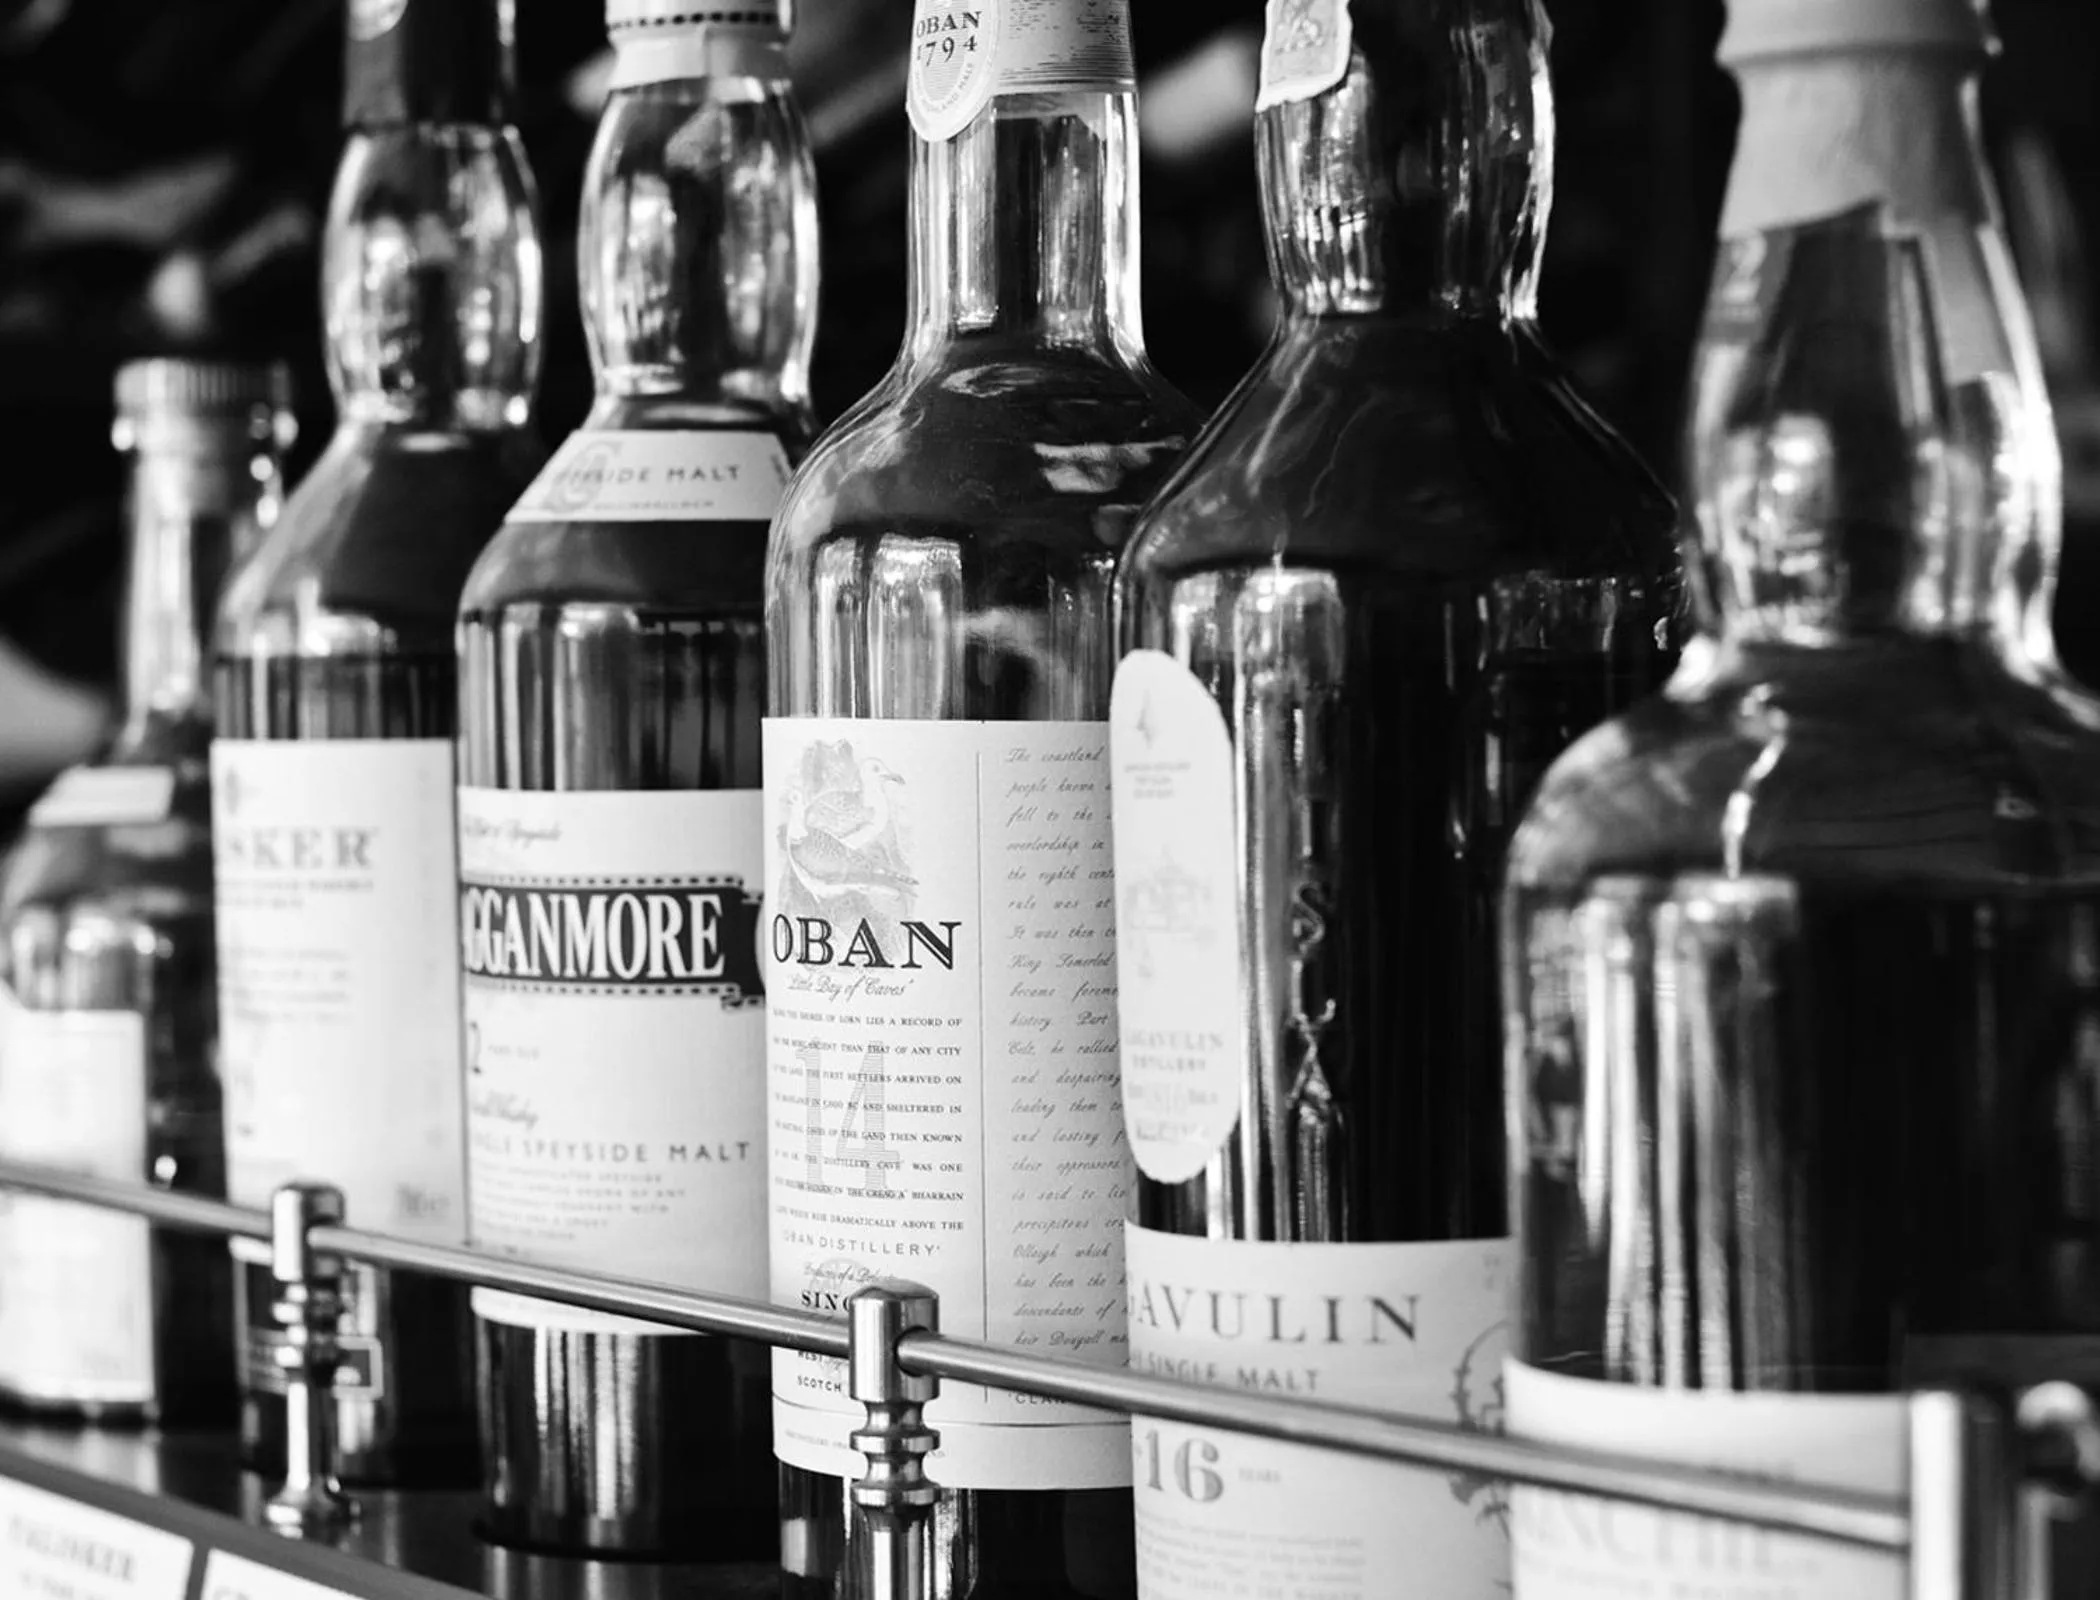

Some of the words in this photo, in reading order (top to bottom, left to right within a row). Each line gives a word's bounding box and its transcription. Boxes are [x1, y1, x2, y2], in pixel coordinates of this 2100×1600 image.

[916, 10, 983, 39] OBAN
[916, 34, 979, 68] 1794
[666, 465, 741, 482] MALT
[1005, 748, 1031, 763] The
[1041, 745, 1106, 762] coastland
[1005, 777, 1048, 799] people
[1057, 777, 1096, 793] known
[1005, 805, 1039, 828] fell
[1046, 809, 1060, 821] to
[1072, 805, 1094, 821] the
[1006, 831, 1080, 856] overlordship
[1091, 839, 1105, 850] in
[1007, 865, 1027, 880] the
[1039, 864, 1081, 886] eighth
[1007, 893, 1037, 910] rule
[1053, 899, 1080, 910] was
[1095, 898, 1111, 910] at
[1006, 923, 1026, 940] It
[1034, 928, 1059, 940] was
[1068, 922, 1095, 940] then
[773, 914, 962, 970] OBAN
[1006, 953, 1043, 974] King
[1008, 981, 1056, 998] became
[889, 1017, 897, 1026] A
[901, 1018, 943, 1027] RECORD
[947, 1018, 962, 1027] OF
[911, 1046, 932, 1055] ANY
[936, 1046, 962, 1056] CITY
[1050, 1039, 1065, 1055] he
[1076, 1038, 1119, 1054] rallied
[895, 1075, 941, 1084] ARRIVED
[945, 1075, 962, 1084] ON
[1011, 1068, 1040, 1085] and
[1055, 1067, 1121, 1090] despairing
[863, 1103, 883, 1112] AND
[886, 1103, 944, 1113] SHELTERED
[950, 1105, 962, 1113] IN
[1011, 1097, 1056, 1119] leading
[1069, 1097, 1098, 1113] them
[890, 1132, 917, 1142] THEN
[922, 1133, 962, 1143] KNOWN
[1012, 1127, 1041, 1143] and
[1052, 1127, 1101, 1149] lasting
[522, 1139, 650, 1163] SPEYSIDE
[668, 1141, 751, 1162] MALT
[912, 1162, 933, 1172] WAS
[939, 1163, 963, 1172] ONE
[1012, 1154, 1043, 1171] their
[912, 1190, 964, 1201] BHARRAIN
[1011, 1187, 1026, 1201] is
[1036, 1185, 1073, 1200] said
[1081, 1188, 1096, 1200] to
[830, 1213, 896, 1228] DRAMATICALLY
[900, 1220, 936, 1229] ABOVE
[942, 1221, 964, 1230] THE
[1012, 1218, 1090, 1236] precipitous
[1075, 1241, 1113, 1259] which
[1014, 1272, 1037, 1288] has
[1048, 1271, 1075, 1289] been
[1087, 1272, 1107, 1287] the
[1013, 1300, 1085, 1317] descendants
[1095, 1298, 1117, 1321] of
[1127, 1278, 1421, 1344] AVULIN
[1014, 1331, 1040, 1346] heir
[1148, 1350, 1218, 1383] SINGLE
[1236, 1365, 1319, 1394] MALT
[797, 1375, 842, 1393] SCOTCH
[1145, 1427, 1225, 1504] 16
